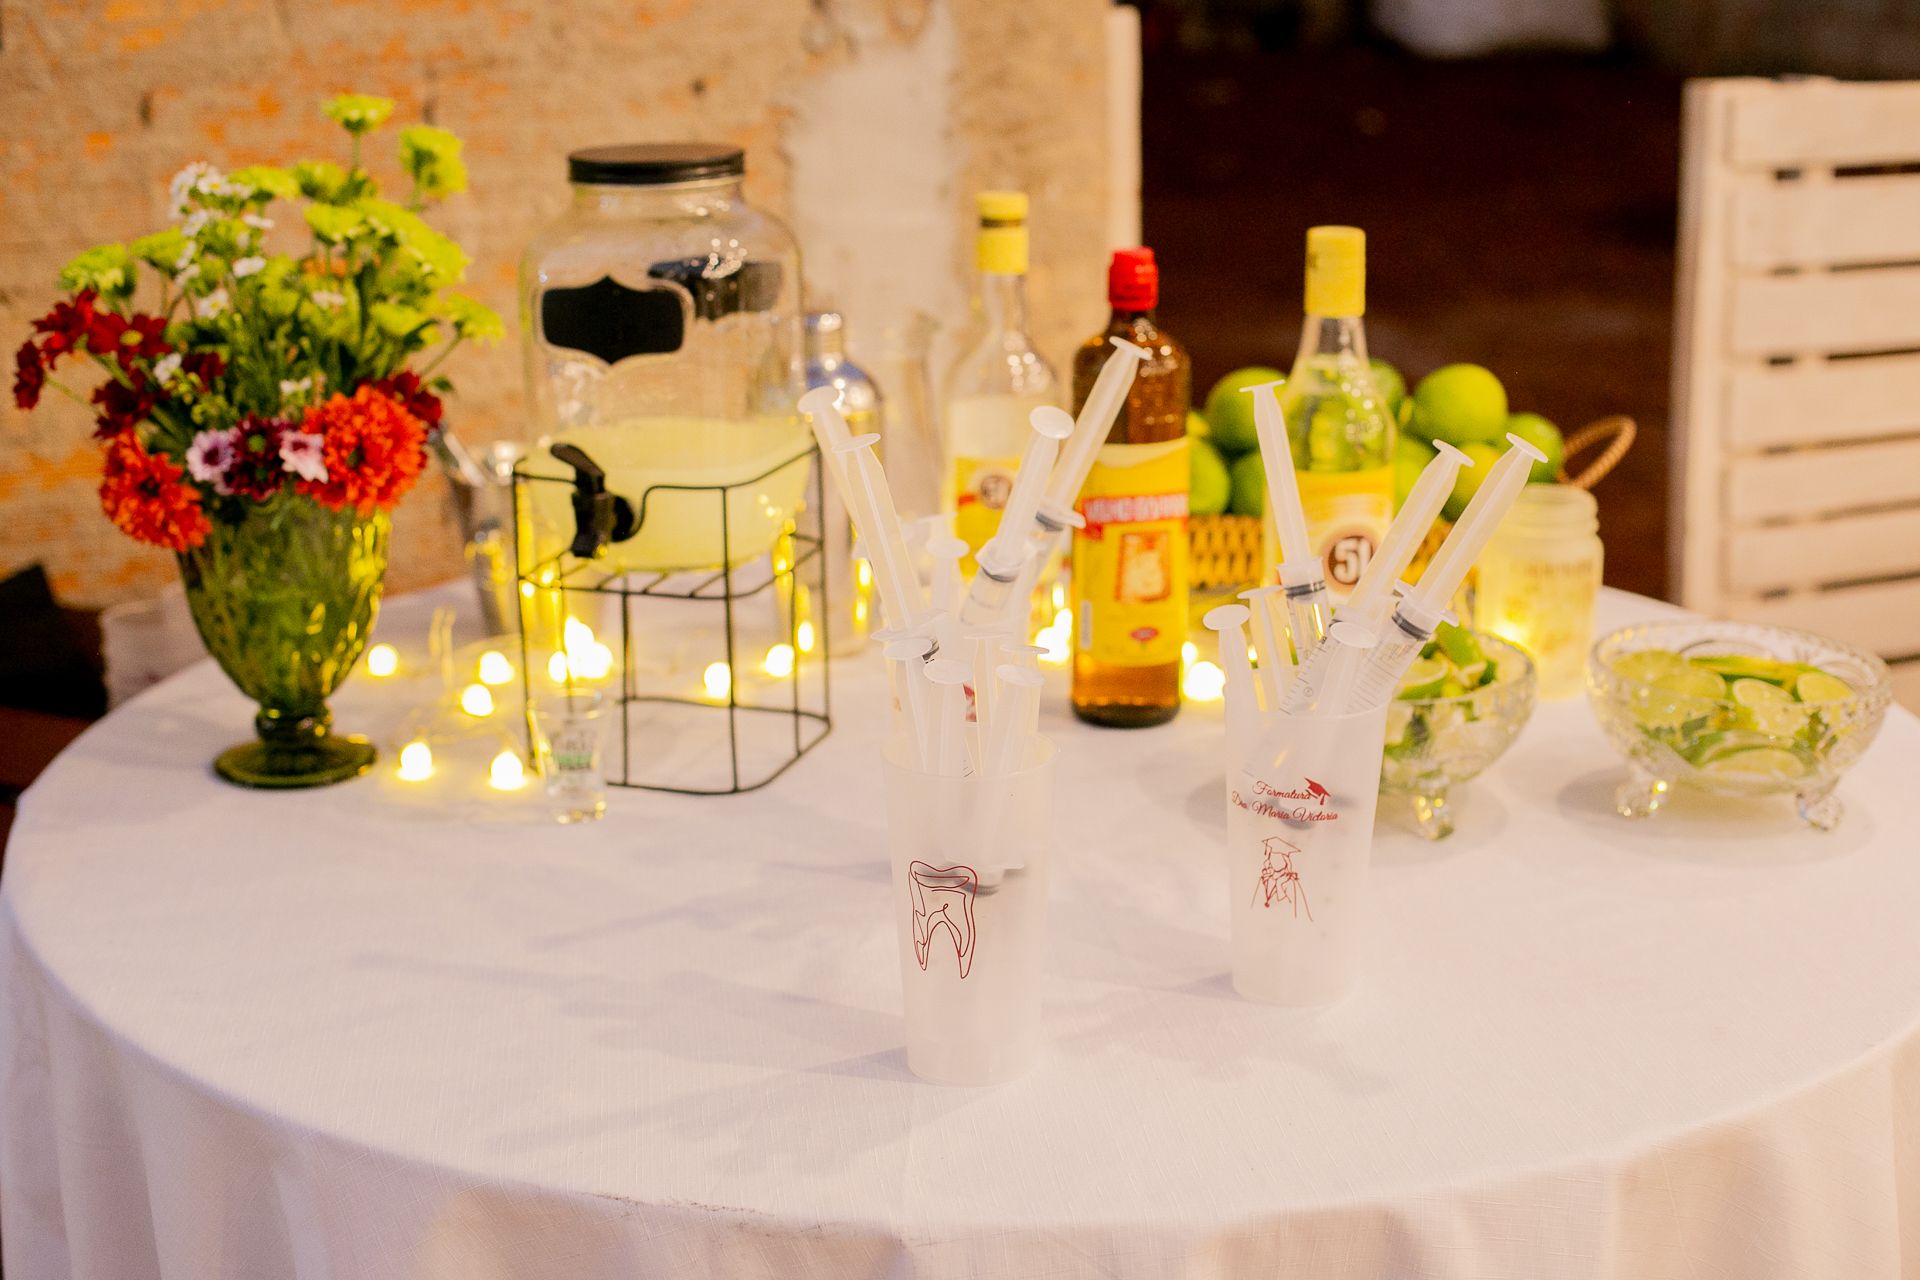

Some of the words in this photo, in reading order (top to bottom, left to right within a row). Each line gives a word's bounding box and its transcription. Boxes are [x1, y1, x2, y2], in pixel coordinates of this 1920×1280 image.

[1333, 538, 1371, 582] 51
[1252, 780, 1311, 800] Formatura
[1252, 801, 1291, 820] Maria
[1292, 807, 1338, 822] Victoria
